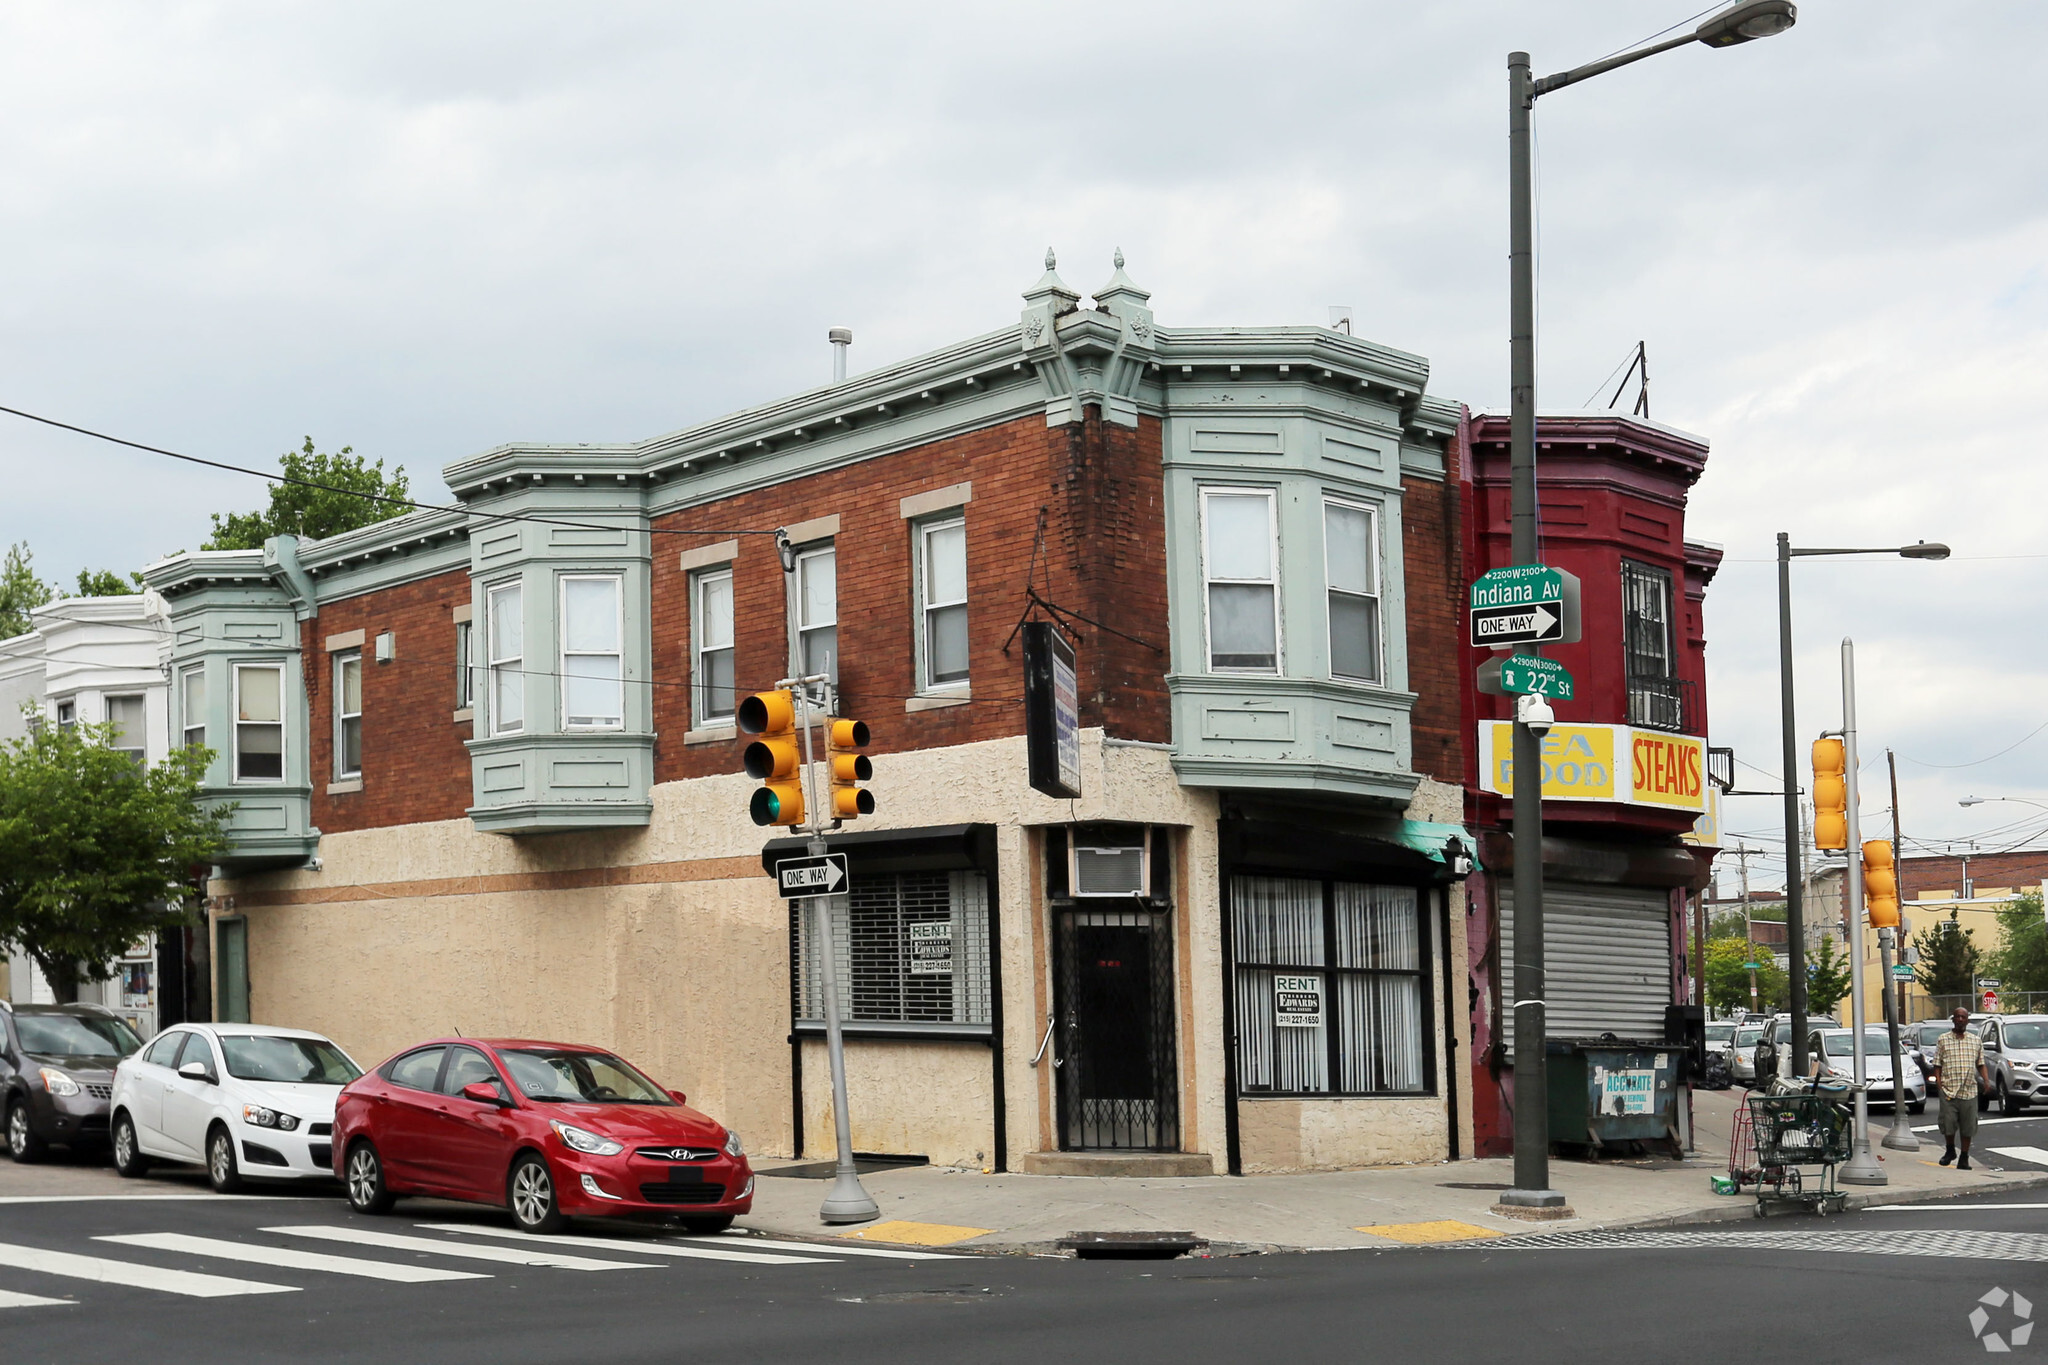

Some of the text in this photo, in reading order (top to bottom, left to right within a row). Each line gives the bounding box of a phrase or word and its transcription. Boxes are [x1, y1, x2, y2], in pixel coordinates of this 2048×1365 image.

[1473, 581, 1560, 606] Indiana Av
[1481, 615, 1535, 634] ONE WAY
[1527, 670, 1571, 696] 22nd St
[1633, 738, 1701, 797] STEAKS
[786, 867, 828, 886] ONE WAY
[912, 924, 950, 938] RENT
[1277, 977, 1317, 990] RENT
[1279, 993, 1318, 1007] EDWARDS
[1984, 997, 1997, 1005] STOP
[1291, 1015, 1319, 1024] 227-1650
[1607, 1075, 1651, 1091] ACCURATE
